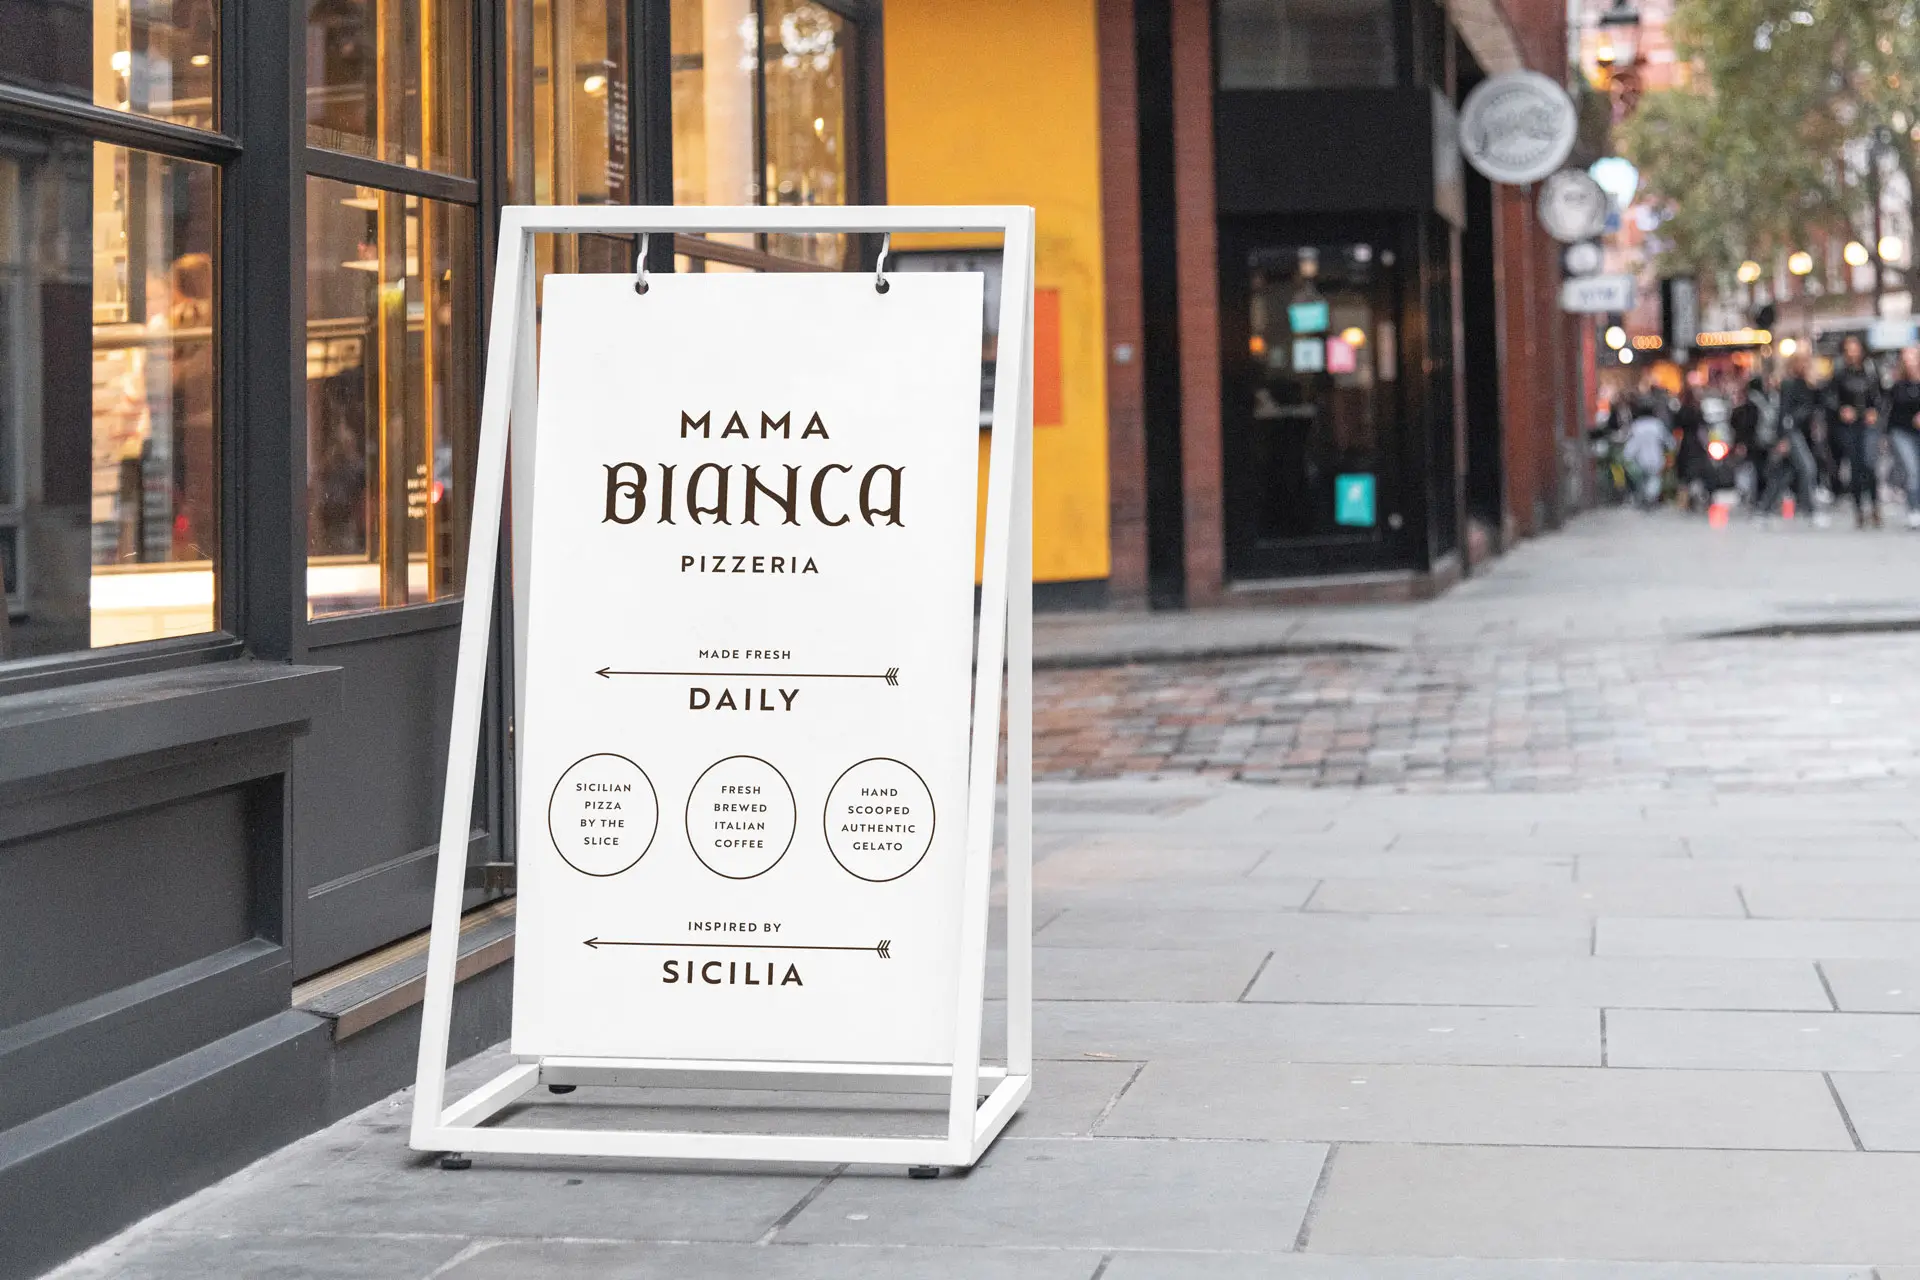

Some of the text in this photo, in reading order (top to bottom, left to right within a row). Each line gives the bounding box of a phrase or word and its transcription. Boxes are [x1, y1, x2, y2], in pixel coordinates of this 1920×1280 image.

[680, 409, 830, 440] MAMA
[600, 461, 907, 528] BIANCA
[680, 554, 820, 575] PIZZERIA
[698, 649, 791, 660] MADE FRESH
[689, 687, 800, 712] DAILY
[575, 782, 632, 793] SICILIAN
[721, 785, 761, 795] FRESH
[861, 787, 898, 797] HAND
[584, 800, 622, 811] PIZZA
[713, 803, 768, 813] BREWED
[847, 805, 910, 816] SCOOPED
[580, 818, 625, 829] BY THE
[714, 820, 765, 831] ITALIAN
[840, 823, 916, 834] AUTHENTIC
[583, 836, 620, 846] SLICE
[714, 838, 764, 849] COFFEE
[852, 841, 903, 852] GELATO
[688, 921, 782, 933] INSPIRED BY
[662, 959, 804, 987] SICILIA
